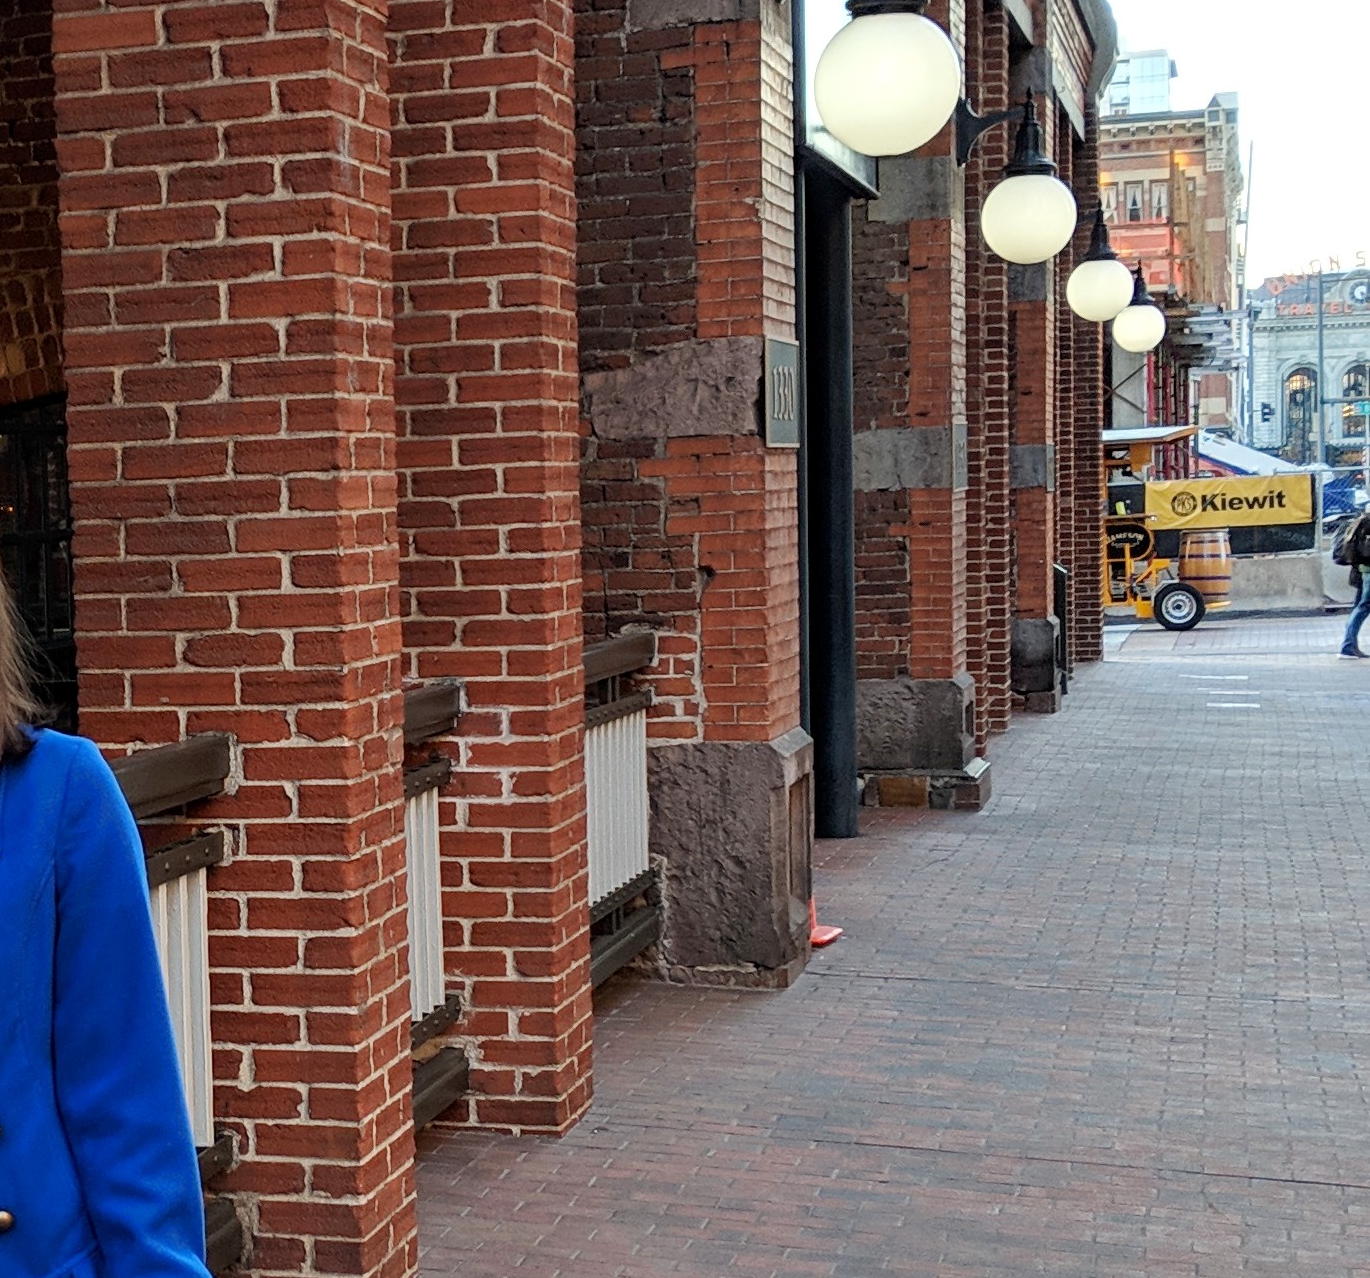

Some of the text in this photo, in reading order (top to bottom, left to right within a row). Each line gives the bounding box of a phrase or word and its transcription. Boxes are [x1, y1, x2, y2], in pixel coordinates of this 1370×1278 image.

[1267, 254, 1341, 295] UNION
[773, 365, 795, 421] 1330
[1201, 490, 1286, 512] Kiewit
